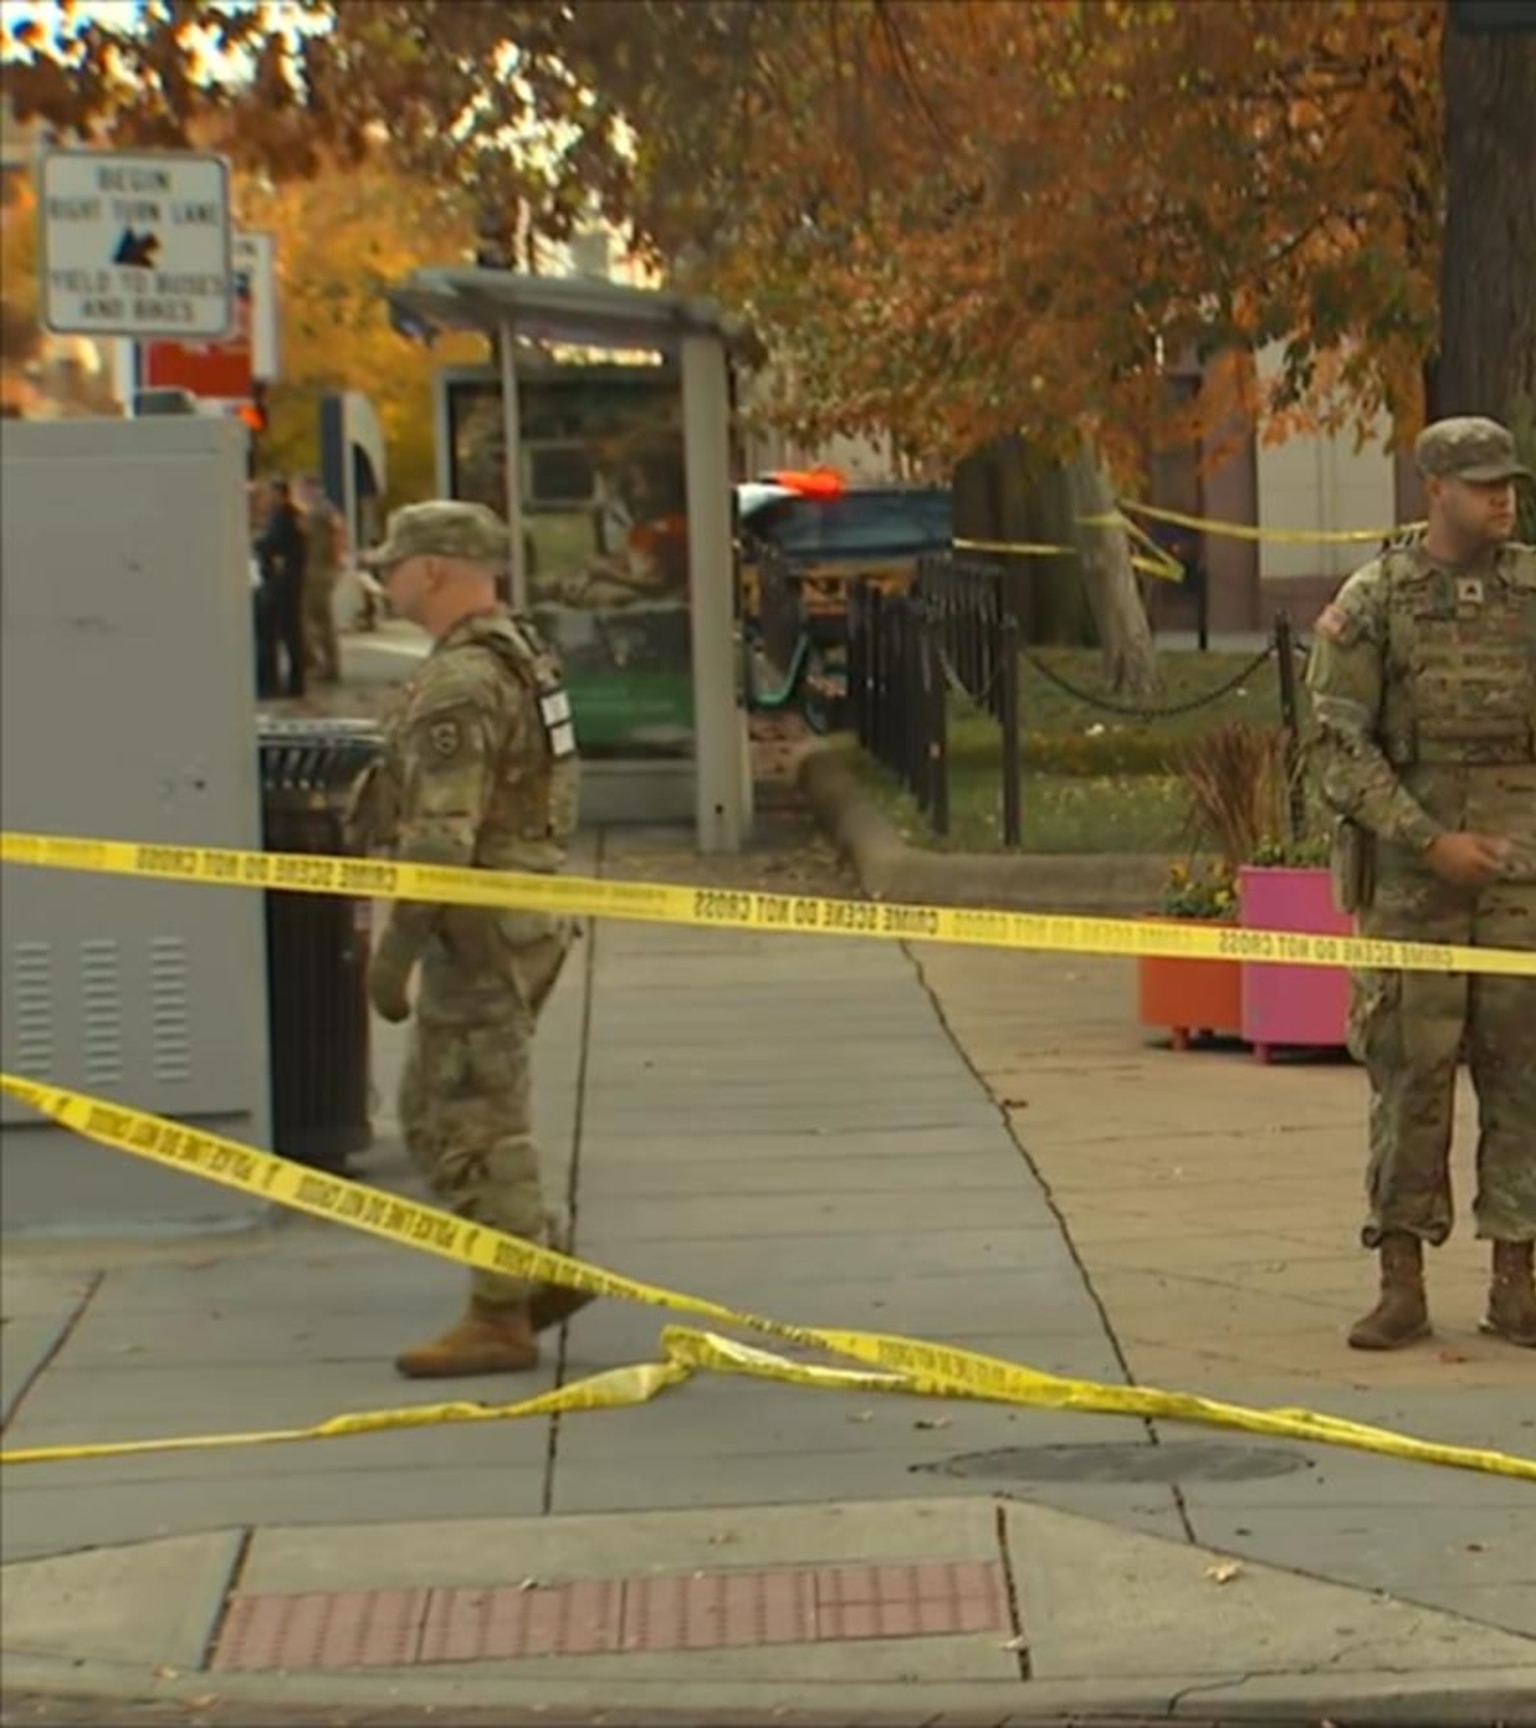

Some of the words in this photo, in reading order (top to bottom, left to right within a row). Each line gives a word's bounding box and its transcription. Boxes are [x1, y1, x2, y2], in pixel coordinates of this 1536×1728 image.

[97, 168, 170, 192] BEGIN
[112, 200, 160, 222] TURN
[171, 202, 218, 225] LANE
[119, 272, 148, 294] TO
[82, 298, 123, 319] AND
[134, 299, 194, 322] BIKES
